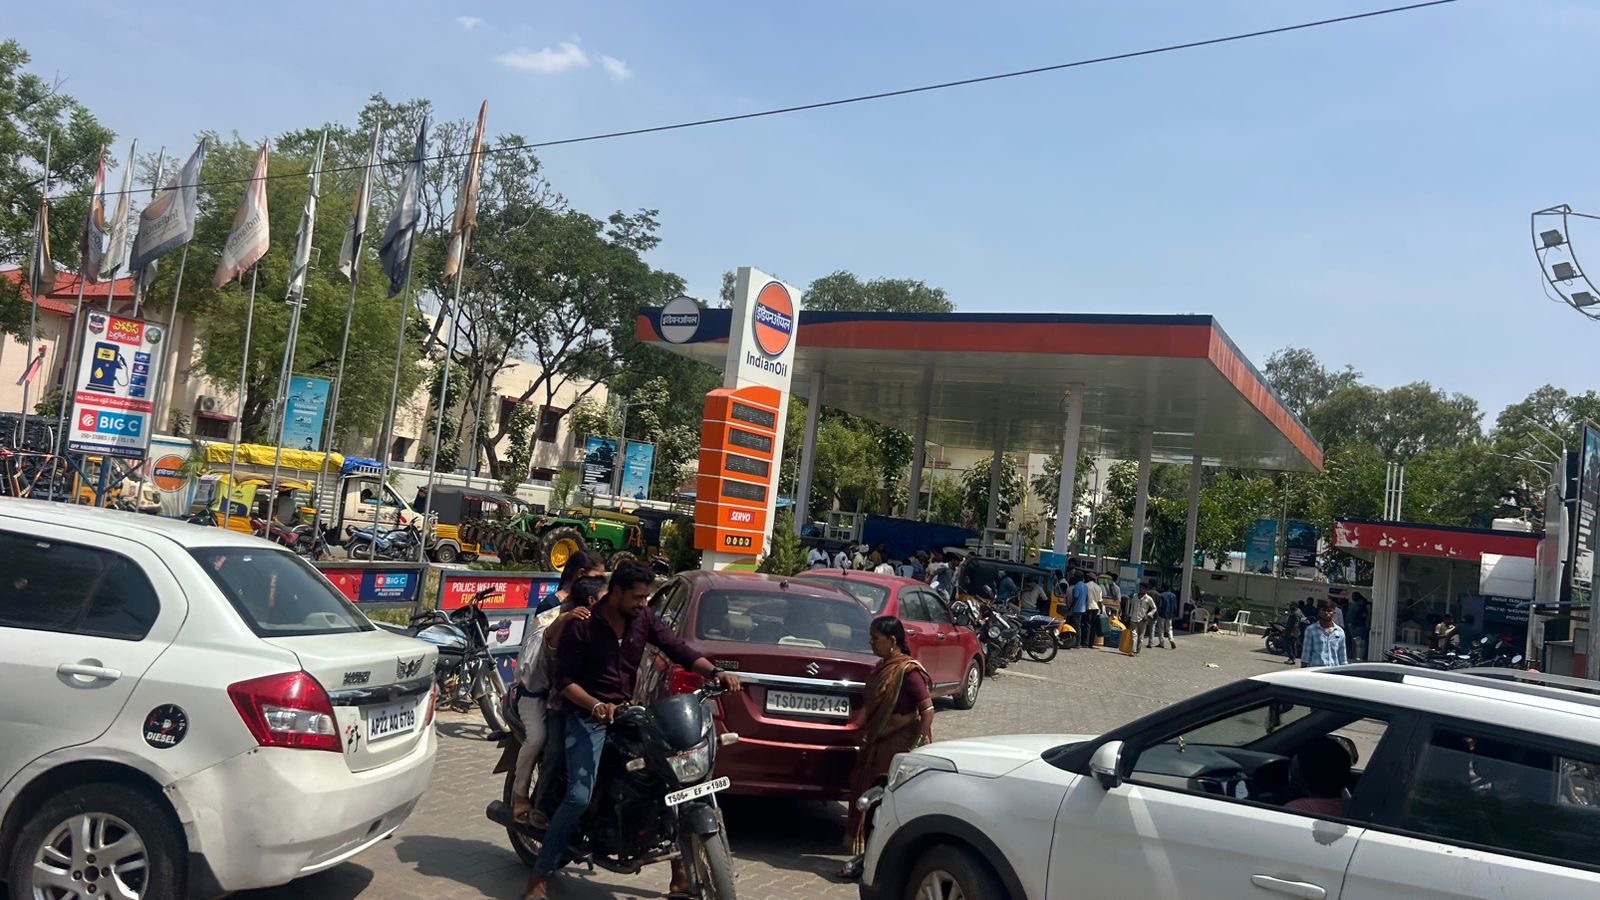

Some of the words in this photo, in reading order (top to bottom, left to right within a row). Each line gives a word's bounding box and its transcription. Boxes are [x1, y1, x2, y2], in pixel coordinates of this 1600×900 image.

[746, 350, 788, 378] IndianOil
[99, 415, 126, 430] BIG
[127, 419, 139, 432] C
[730, 511, 751, 523] SERVO
[385, 576, 399, 585] BIG
[399, 577, 406, 585] C
[451, 582, 476, 593] POLICE
[774, 693, 848, 713] TS07GB2149
[370, 716, 388, 736] AP22
[389, 713, 399, 731] AQ
[399, 710, 415, 729] 6789
[146, 731, 176, 744] DIESEL
[693, 786, 703, 796] EF
[711, 778, 728, 791] 1988
